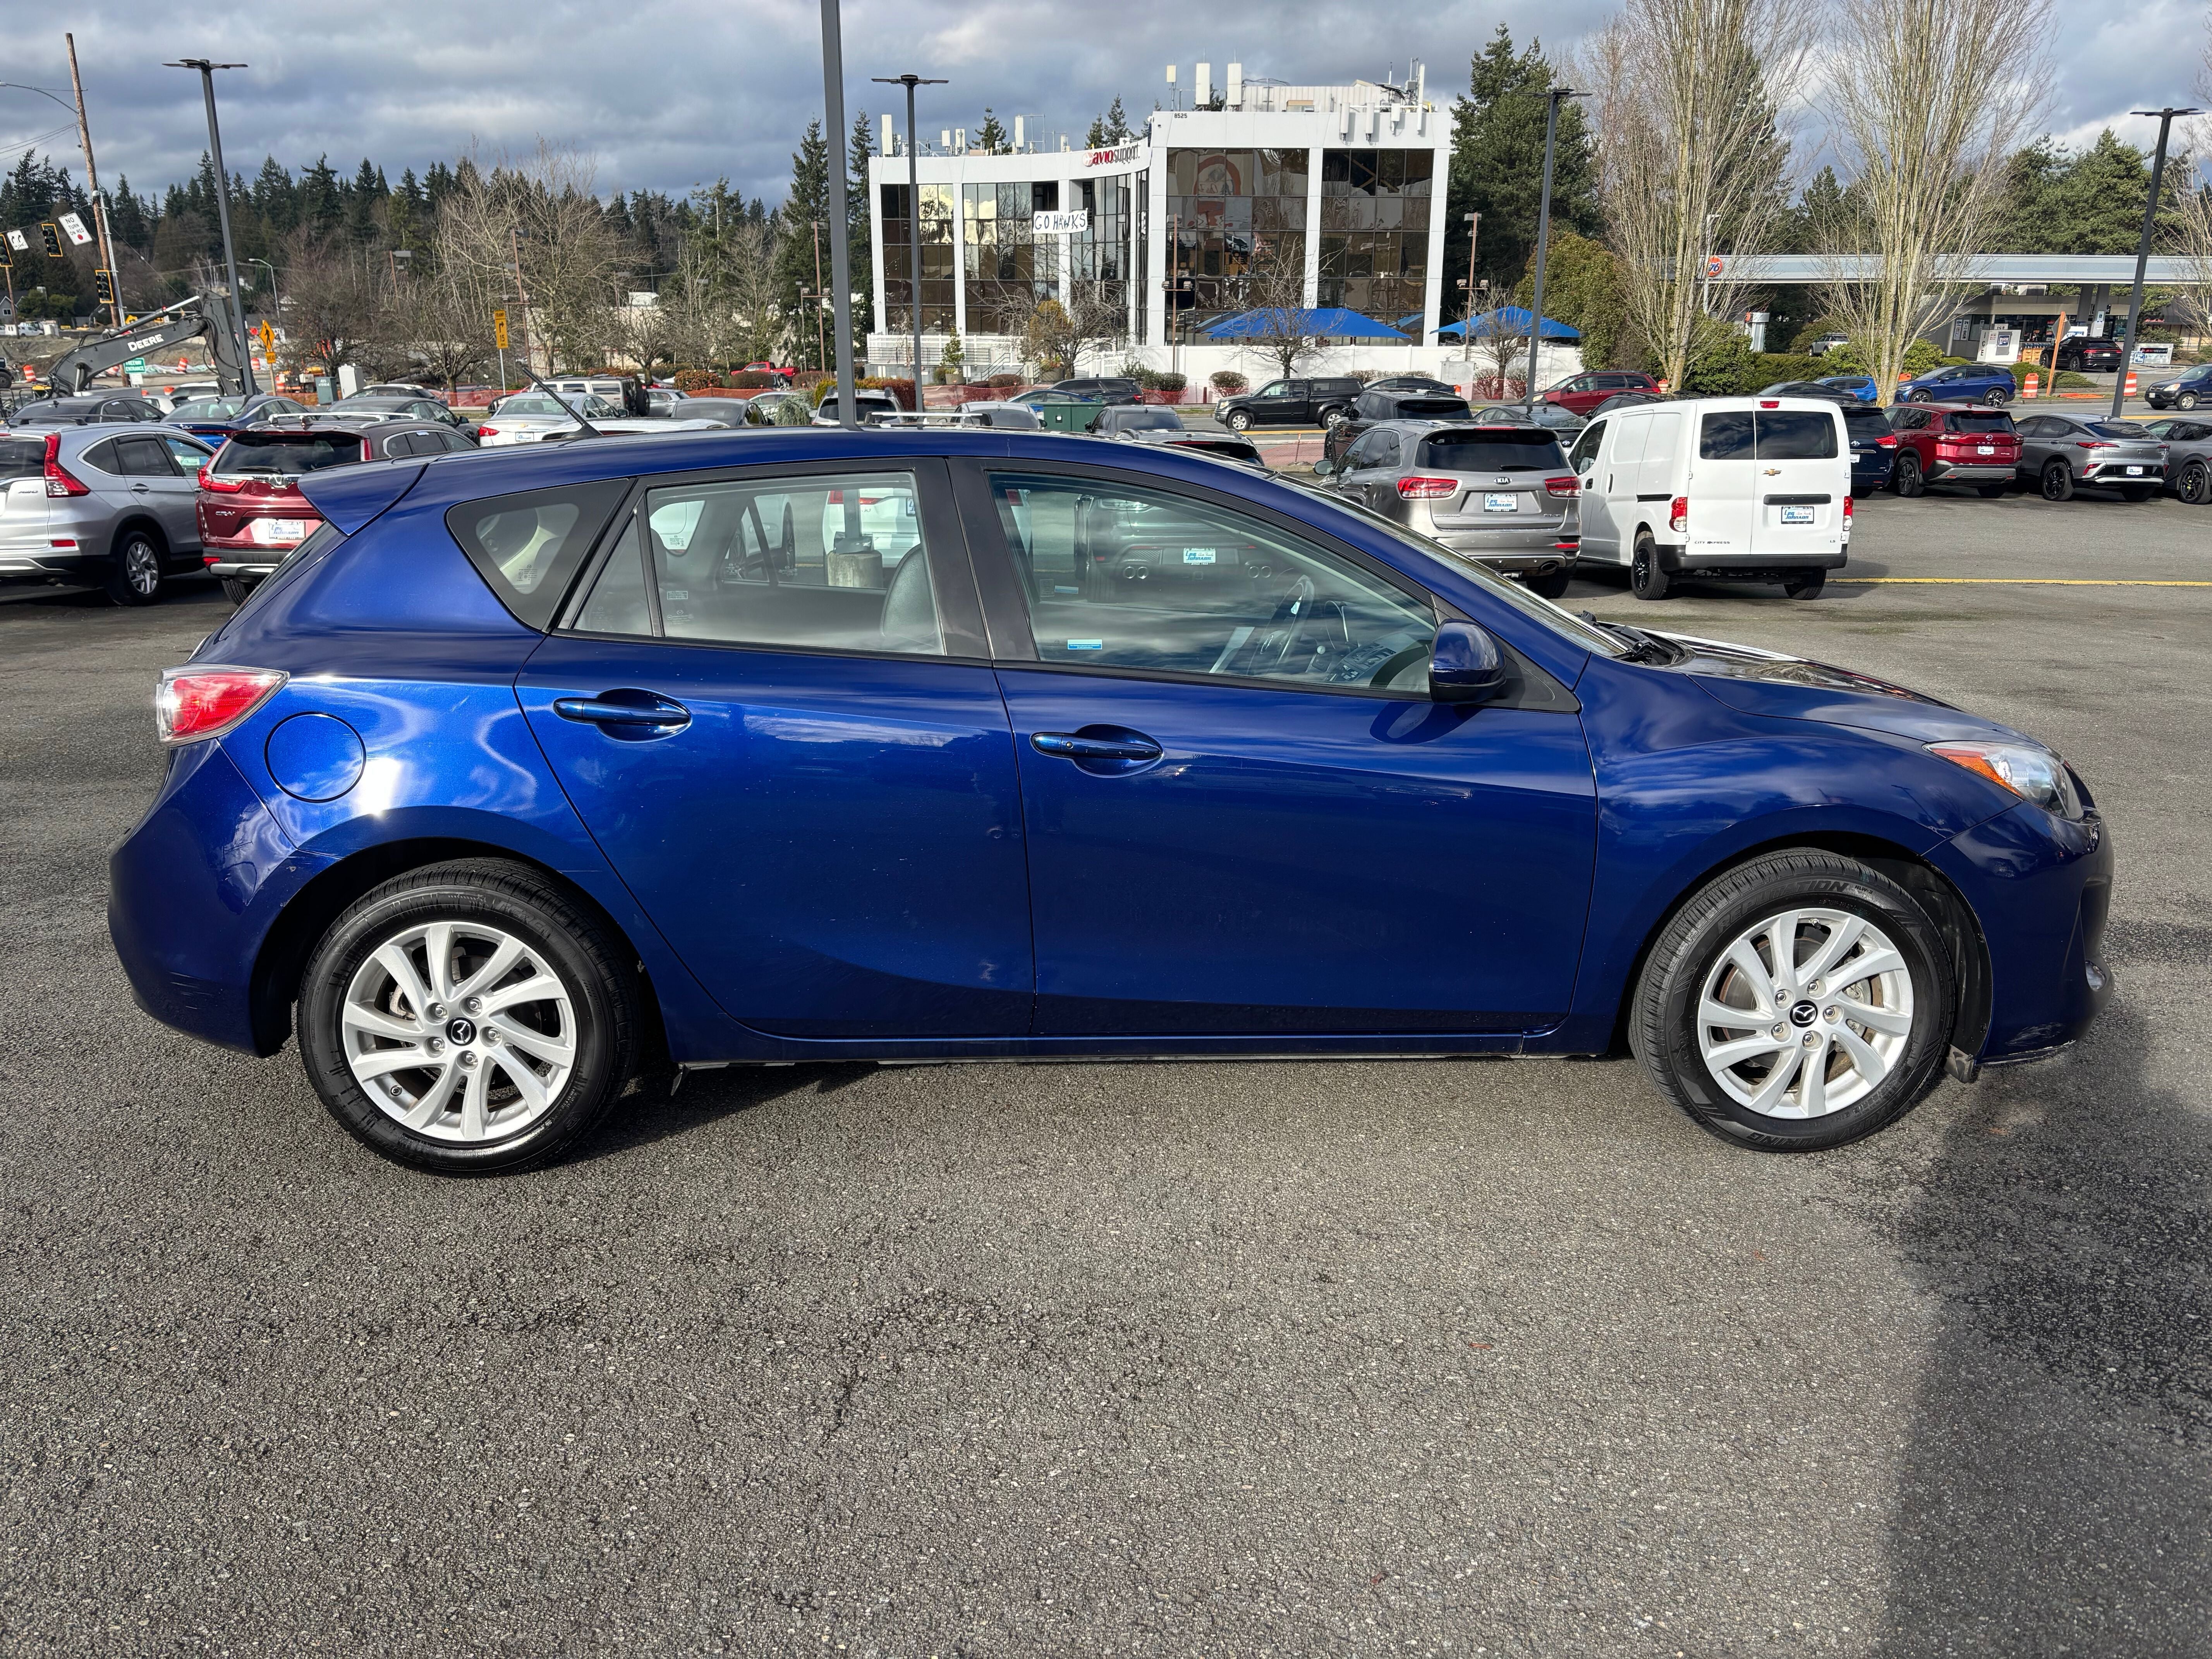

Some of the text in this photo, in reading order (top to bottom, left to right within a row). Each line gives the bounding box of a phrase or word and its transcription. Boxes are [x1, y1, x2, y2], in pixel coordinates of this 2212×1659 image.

[1092, 142, 1140, 165] aviosupport
[1035, 213, 1085, 230] GO HAWKS
[1710, 262, 1720, 272] 76
[127, 334, 164, 352] DEERE
[1718, 881, 1849, 934] REPUTATION
